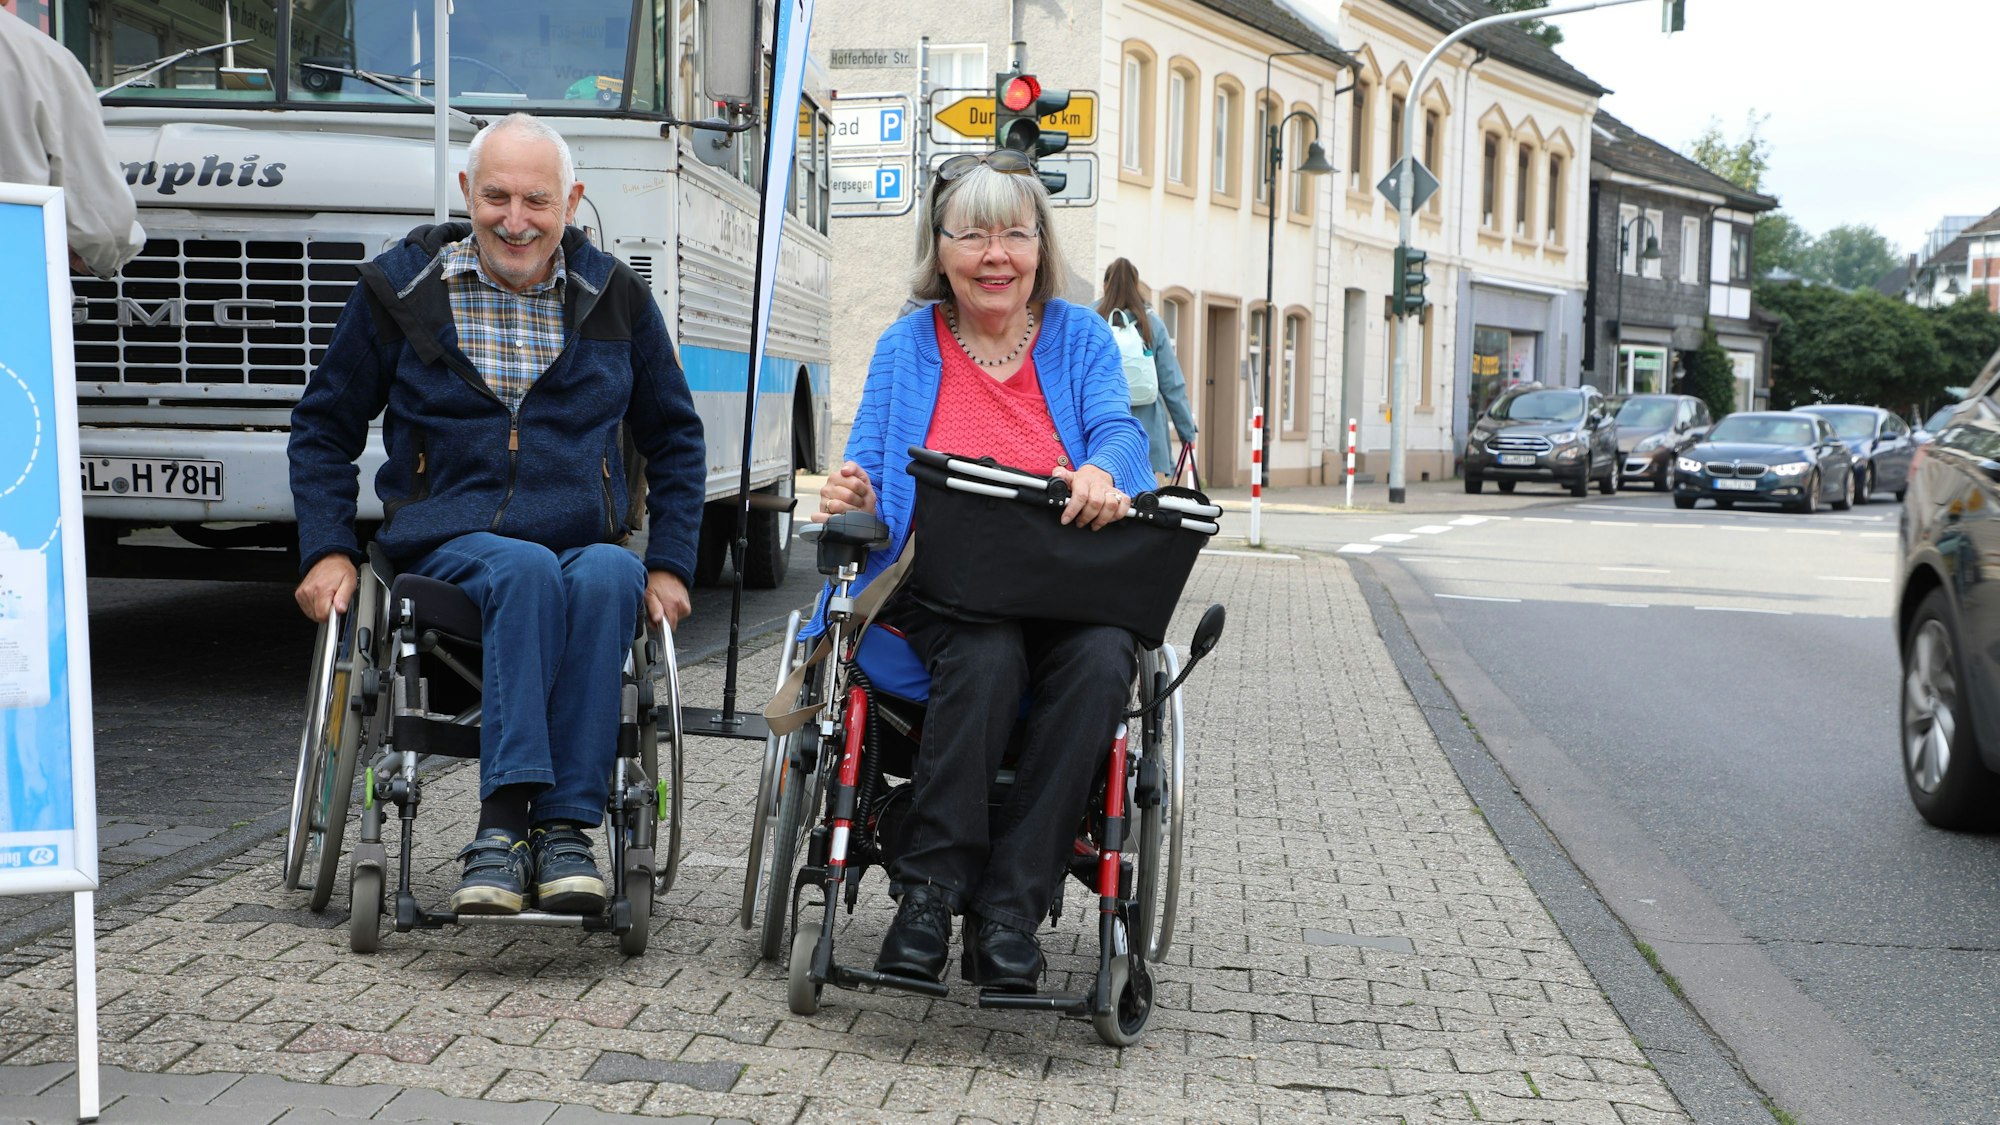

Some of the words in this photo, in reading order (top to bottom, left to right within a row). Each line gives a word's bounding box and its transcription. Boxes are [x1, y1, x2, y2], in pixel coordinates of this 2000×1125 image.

[831, 52, 887, 65] Hofferhofer
[894, 52, 910, 64] Str.
[884, 113, 899, 139] P
[1062, 109, 1080, 125] km
[120, 154, 286, 195] mphis
[831, 180, 873, 193] ergsegen
[881, 171, 896, 196] P
[132, 463, 153, 493] H
[161, 464, 221, 496] 78H
